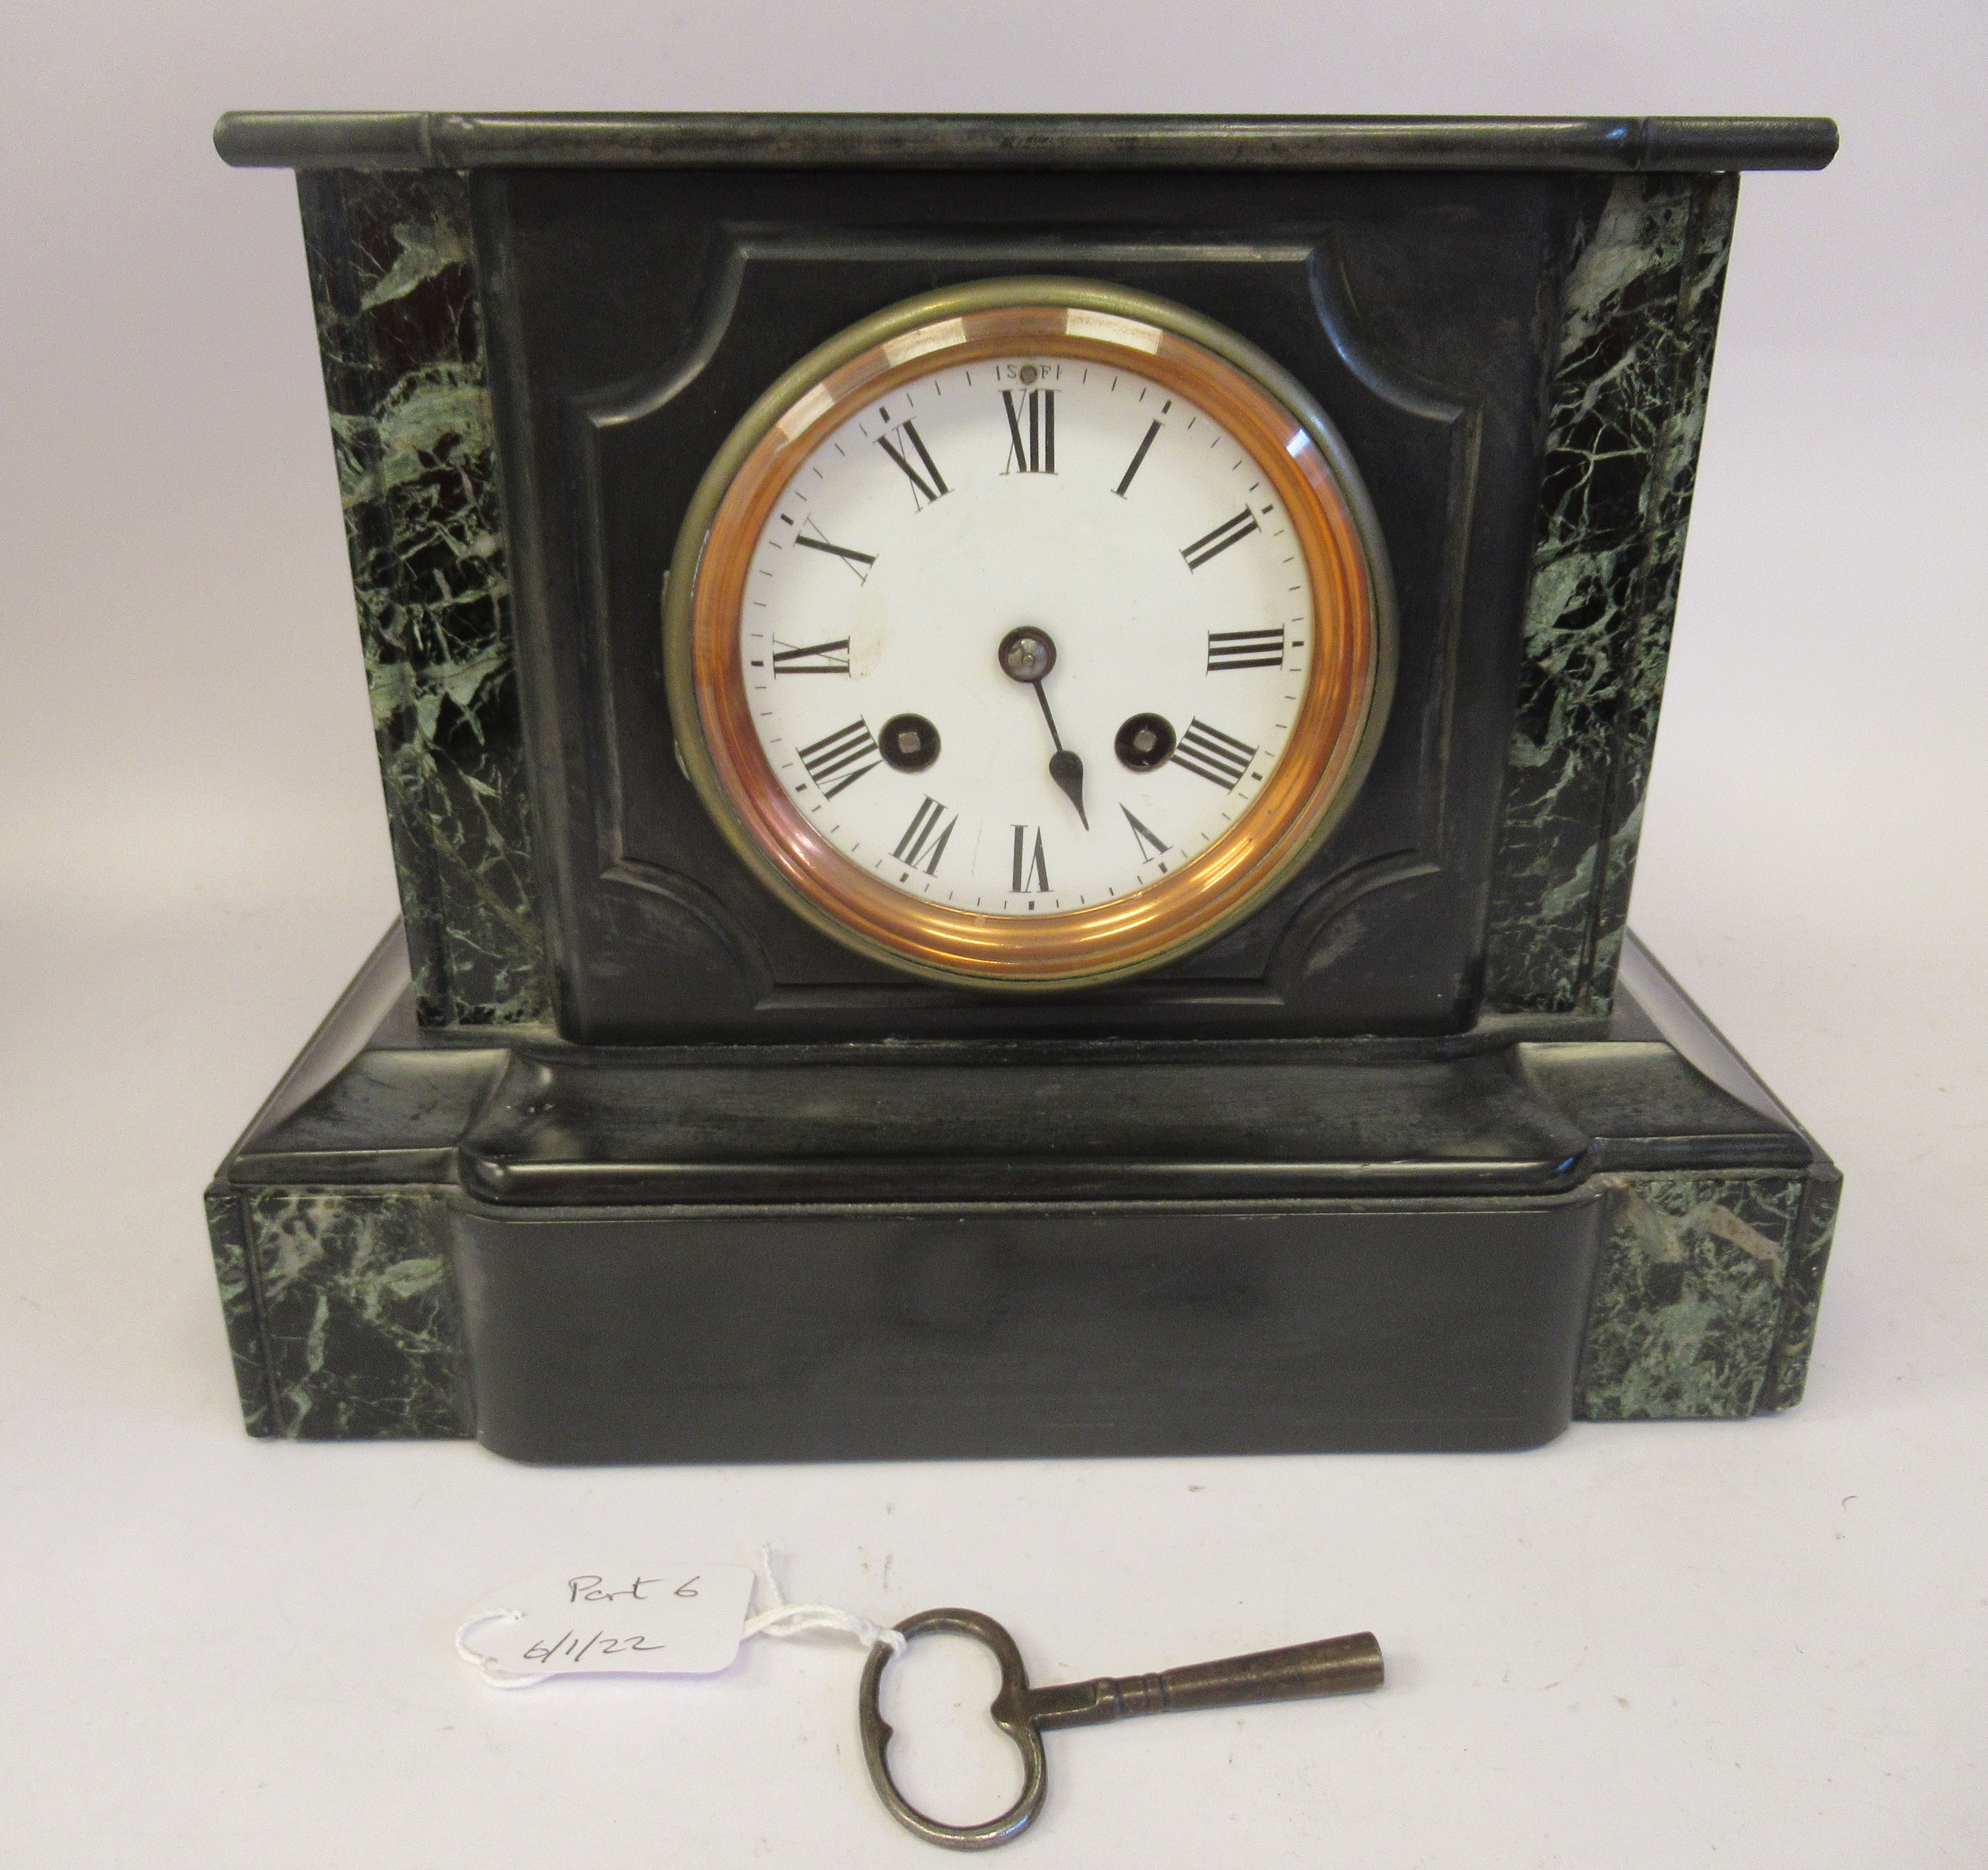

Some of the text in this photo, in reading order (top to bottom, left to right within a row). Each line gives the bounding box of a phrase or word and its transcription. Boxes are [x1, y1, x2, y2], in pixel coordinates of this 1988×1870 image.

[873, 416, 955, 513] XI
[998, 388, 1063, 476] XII
[1111, 418, 1165, 500] I
[792, 513, 879, 586] X
[1179, 503, 1261, 574] II
[772, 633, 851, 679] IX
[1206, 624, 1285, 675] III
[796, 715, 884, 801] VIII
[1168, 716, 1259, 794] IIII
[889, 794, 959, 879] VII
[1009, 824, 1055, 893] VI
[1117, 802, 1174, 865] V
[569, 1575, 701, 1602] Part 6
[523, 1629, 665, 1664] 6/1/22
